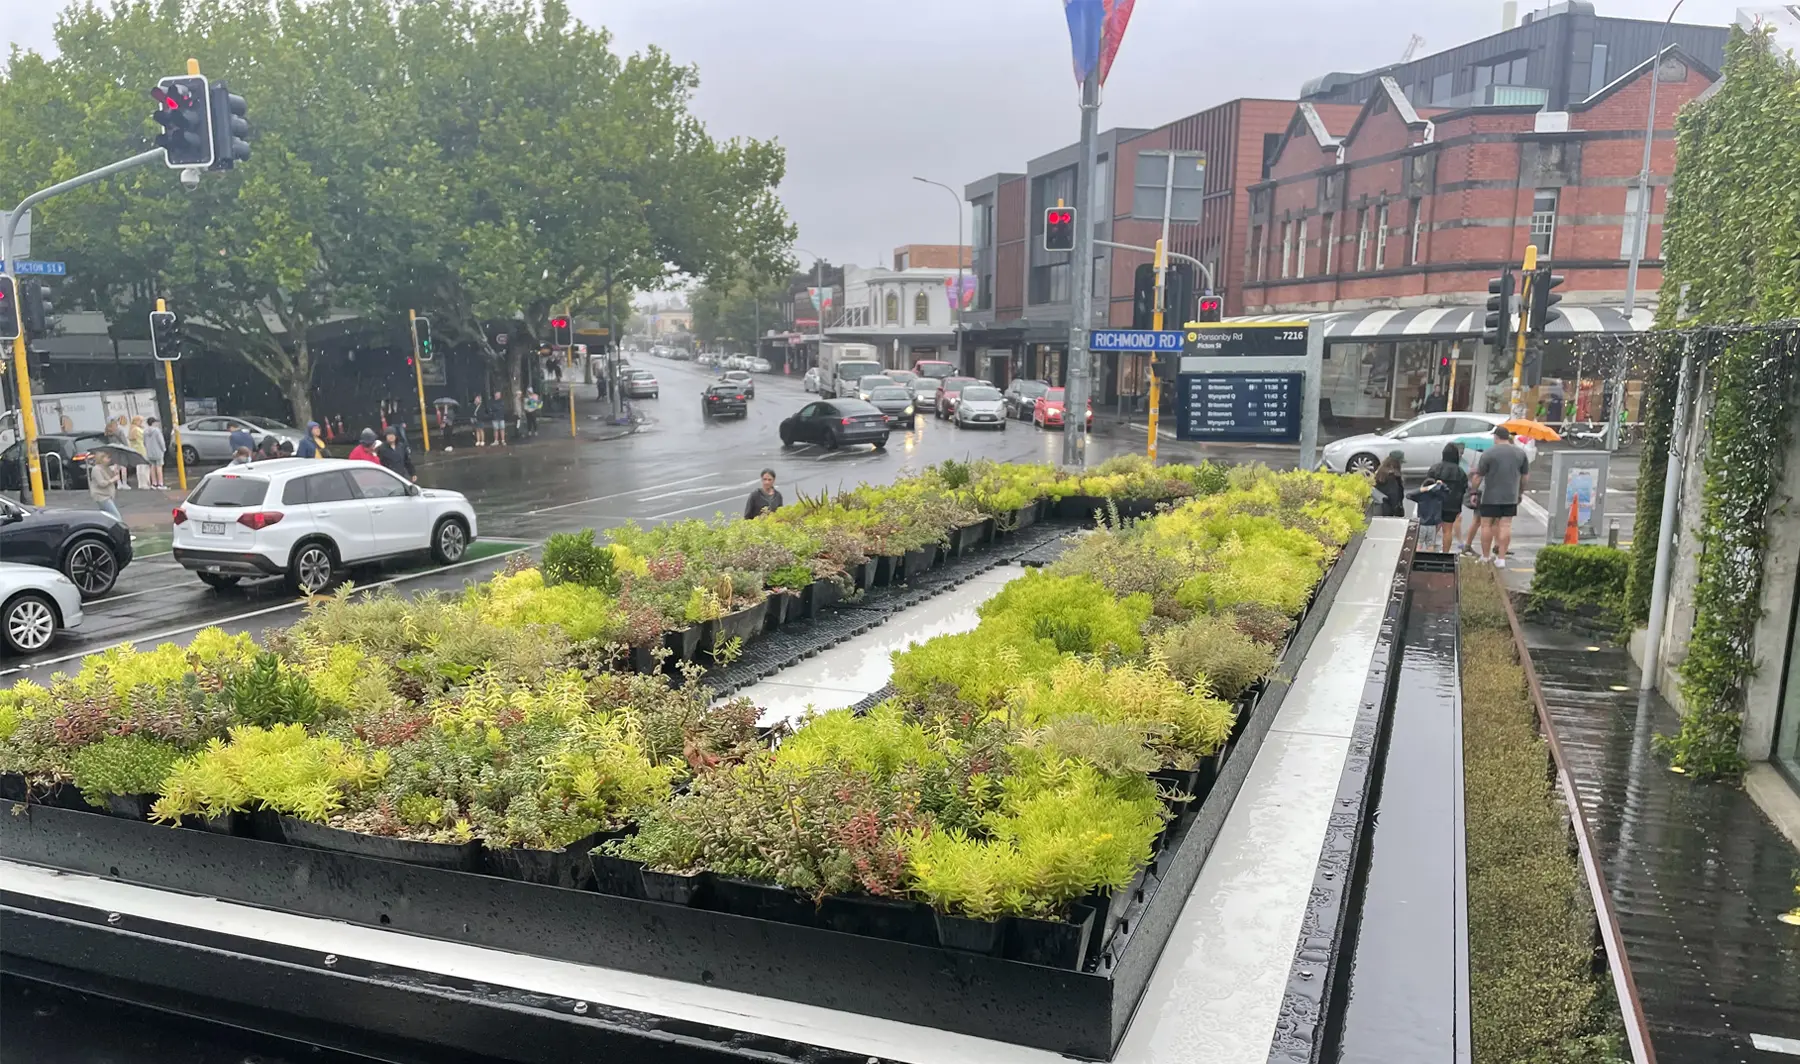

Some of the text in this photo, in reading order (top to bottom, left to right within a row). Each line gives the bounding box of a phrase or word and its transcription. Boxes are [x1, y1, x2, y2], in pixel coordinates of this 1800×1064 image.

[16, 263, 43, 273] PICTON
[1198, 333, 1243, 342] Ponsonby Rd
[1283, 331, 1304, 340] 7216
[1095, 333, 1176, 348] RICHMOND RD
